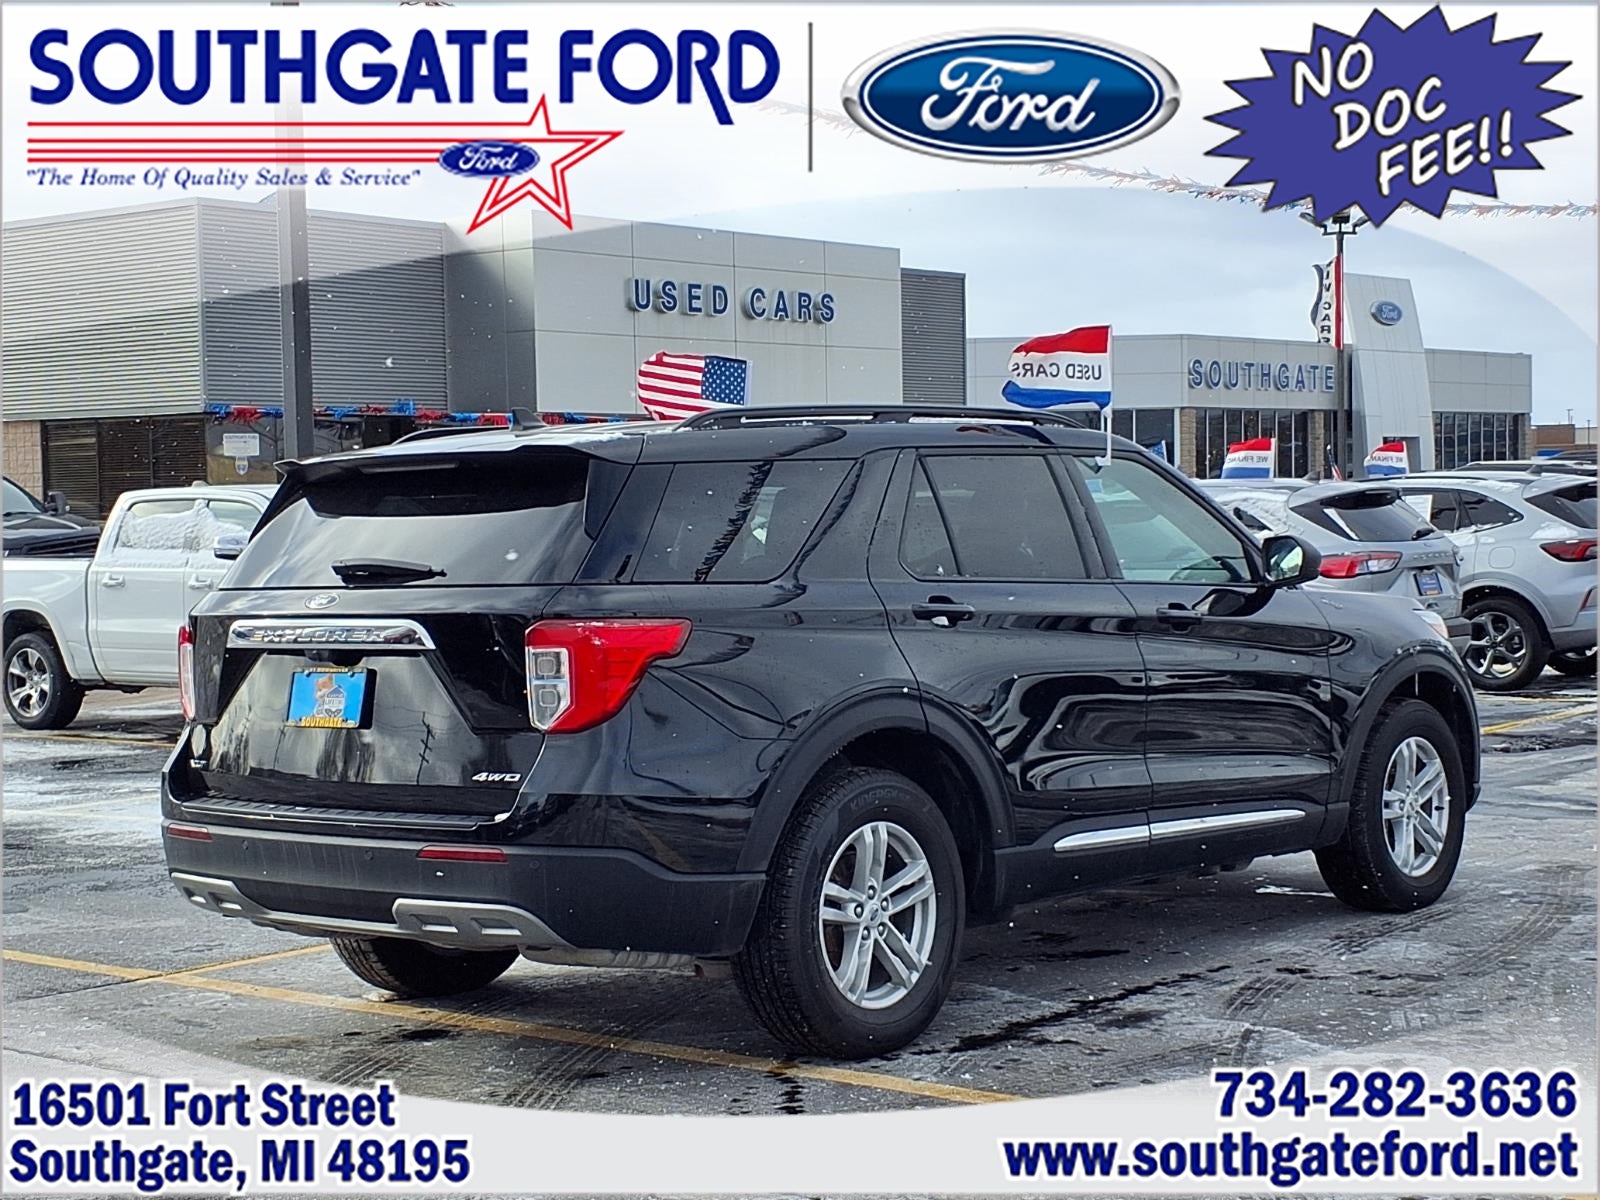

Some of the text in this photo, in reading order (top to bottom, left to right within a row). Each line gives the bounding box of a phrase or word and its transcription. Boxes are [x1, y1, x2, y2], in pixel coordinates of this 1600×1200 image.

[629, 278, 836, 324] USED CARS
[1189, 357, 1336, 392] SOUTHGATE
[249, 628, 386, 643] EXPLORER
[471, 772, 521, 781] 4WD
